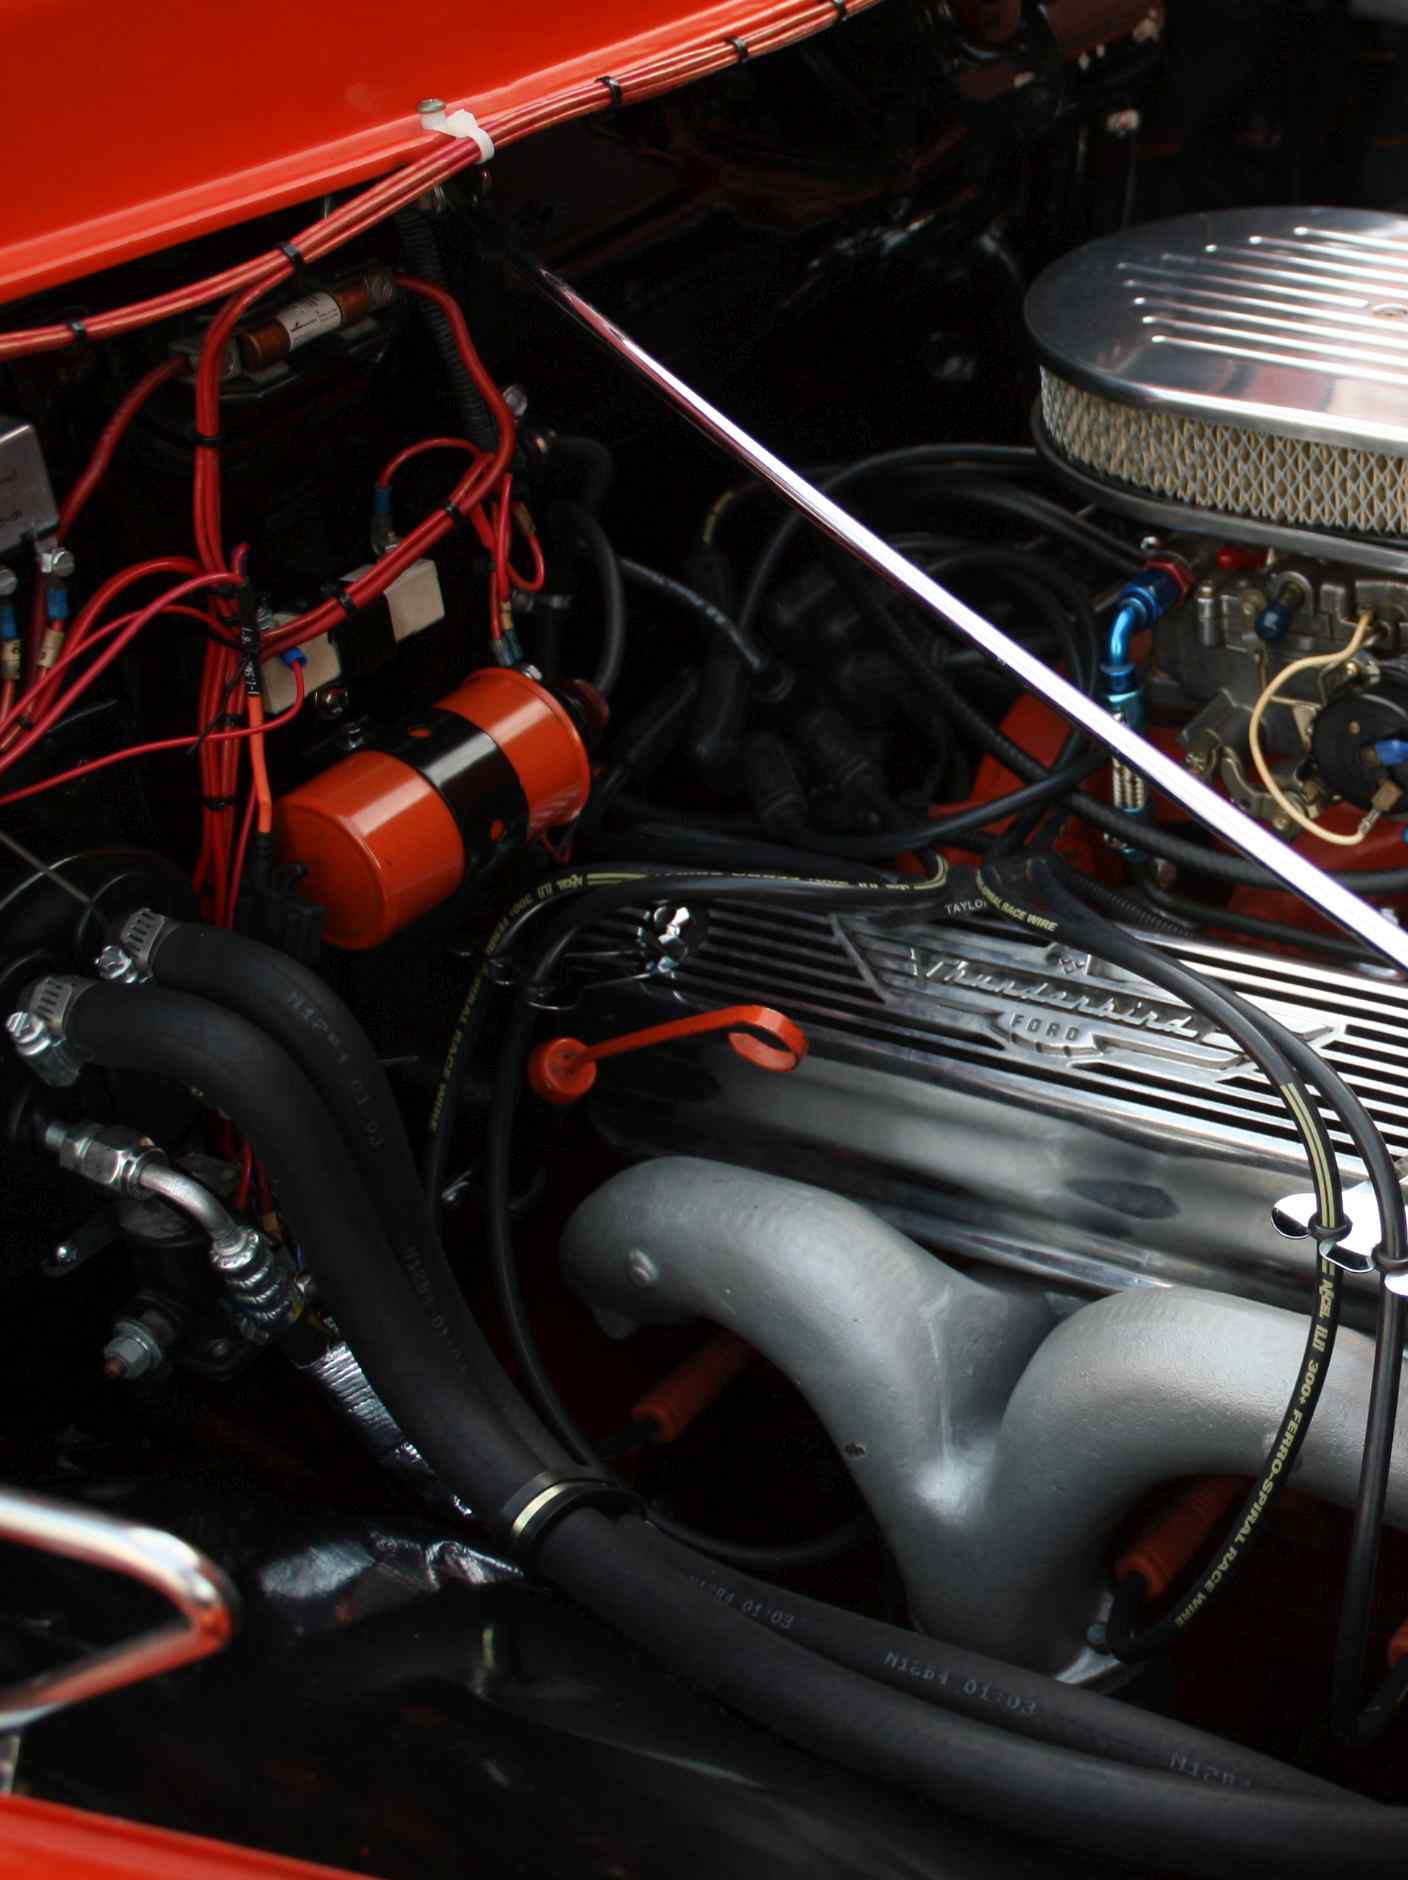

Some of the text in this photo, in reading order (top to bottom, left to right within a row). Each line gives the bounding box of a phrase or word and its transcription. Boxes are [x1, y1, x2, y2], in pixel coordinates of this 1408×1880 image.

[910, 947, 1199, 1039] Thunderbird
[1010, 1012, 1081, 1043] FORD
[1234, 1409, 1304, 1545] FERRO-SPIRAL
[1204, 1546, 1238, 1593] RACE
[1174, 1591, 1208, 1628] WIRE
